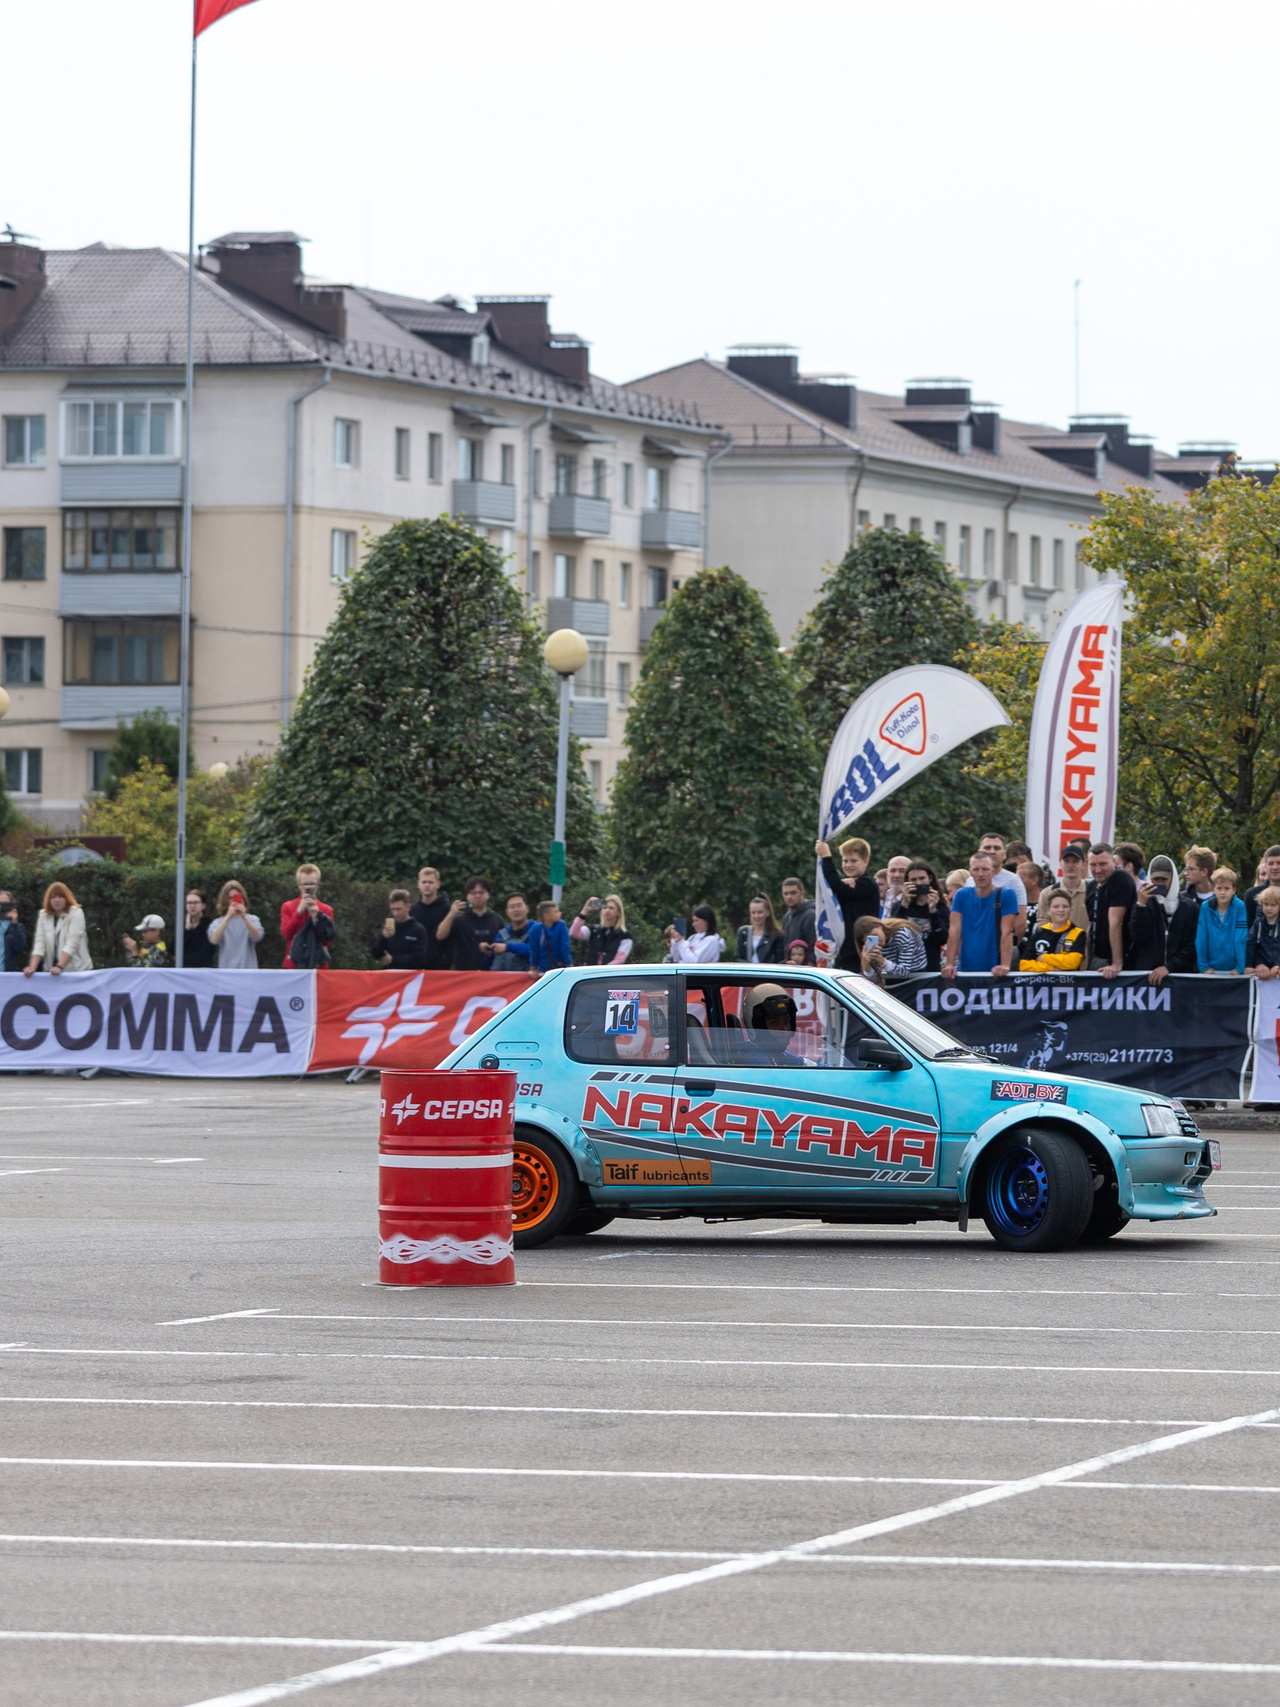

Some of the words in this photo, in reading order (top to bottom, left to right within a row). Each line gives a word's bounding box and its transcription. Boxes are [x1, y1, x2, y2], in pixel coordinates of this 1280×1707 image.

[897, 717, 920, 739] Dinol
[916, 986, 1171, 1015] ПОДШИПНИКИ
[609, 1003, 635, 1031] 14
[988, 1043, 1019, 1054] 121/4
[999, 1081, 1061, 1100] ADT.BY
[424, 1099, 503, 1120] CEPSA
[582, 1085, 938, 1169] NAKAYAMA
[605, 1163, 640, 1181] Taif
[643, 1170, 710, 1182] lubricants
